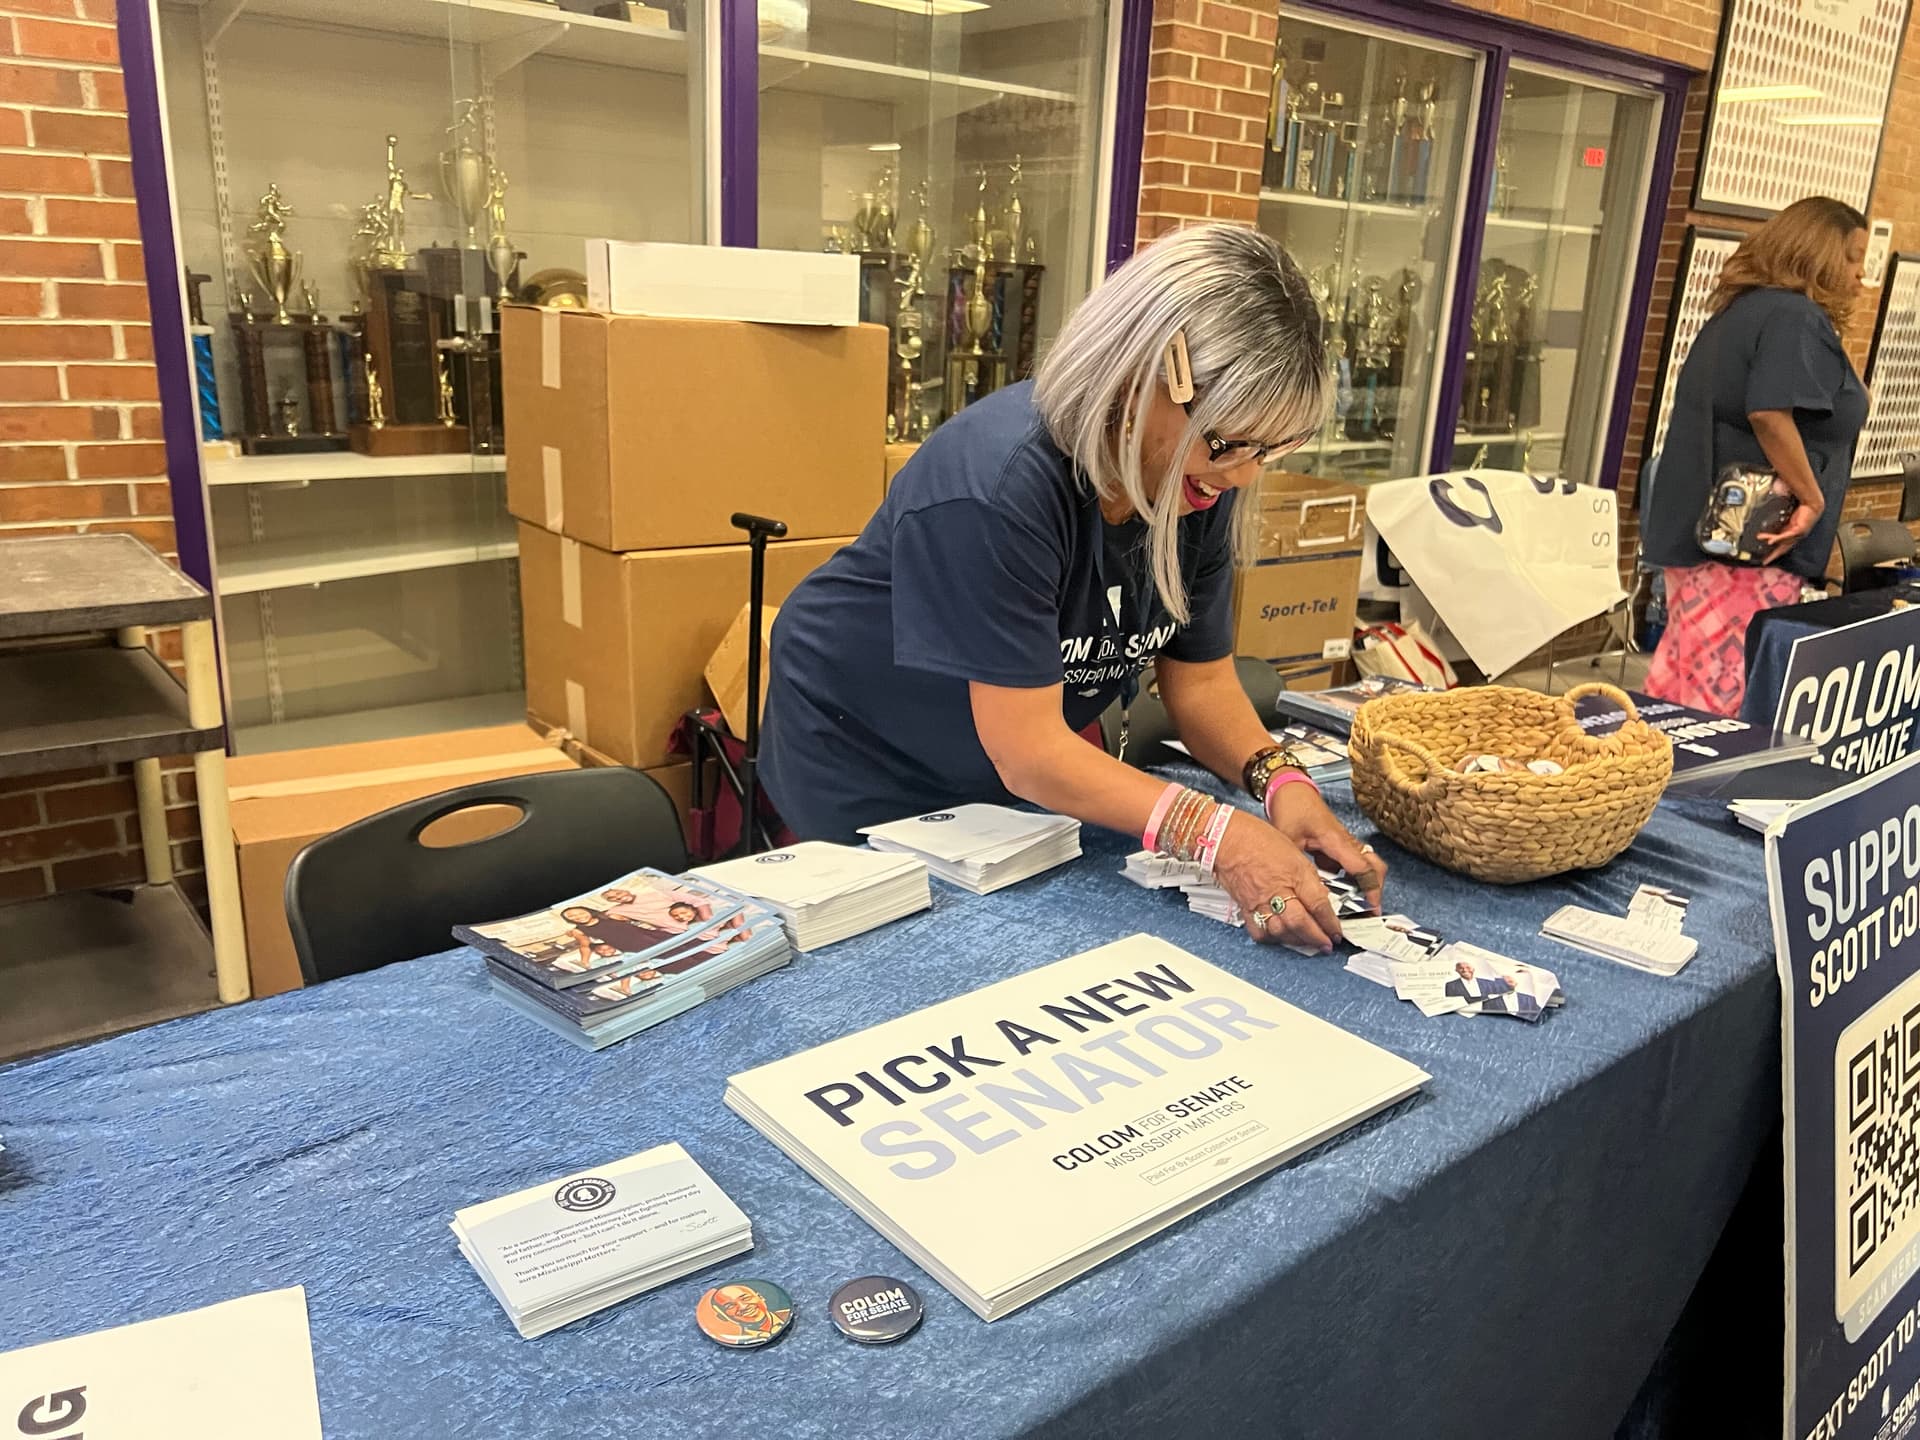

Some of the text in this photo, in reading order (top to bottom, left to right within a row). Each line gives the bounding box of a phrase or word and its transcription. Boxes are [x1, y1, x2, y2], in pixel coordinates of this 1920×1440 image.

[1260, 597, 1338, 621] Sport-Tek
[1783, 644, 1920, 747] COLOM
[1809, 883, 1920, 1008] SCOTT CO
[803, 964, 1196, 1128] PICK A NEW
[860, 996, 1280, 1181] SENATOR
[1052, 1075, 1254, 1171] COLOM FOR SENATE
[1104, 1100, 1246, 1170] MISSISSIPPI MATTERS
[514, 1266, 539, 1278] Thank
[840, 1287, 905, 1315] COLOM
[846, 1309, 869, 1322] FOR
[868, 1298, 910, 1315] SENATE
[1847, 1331, 1895, 1415] SCOTT
[1896, 1307, 1915, 1353] TO
